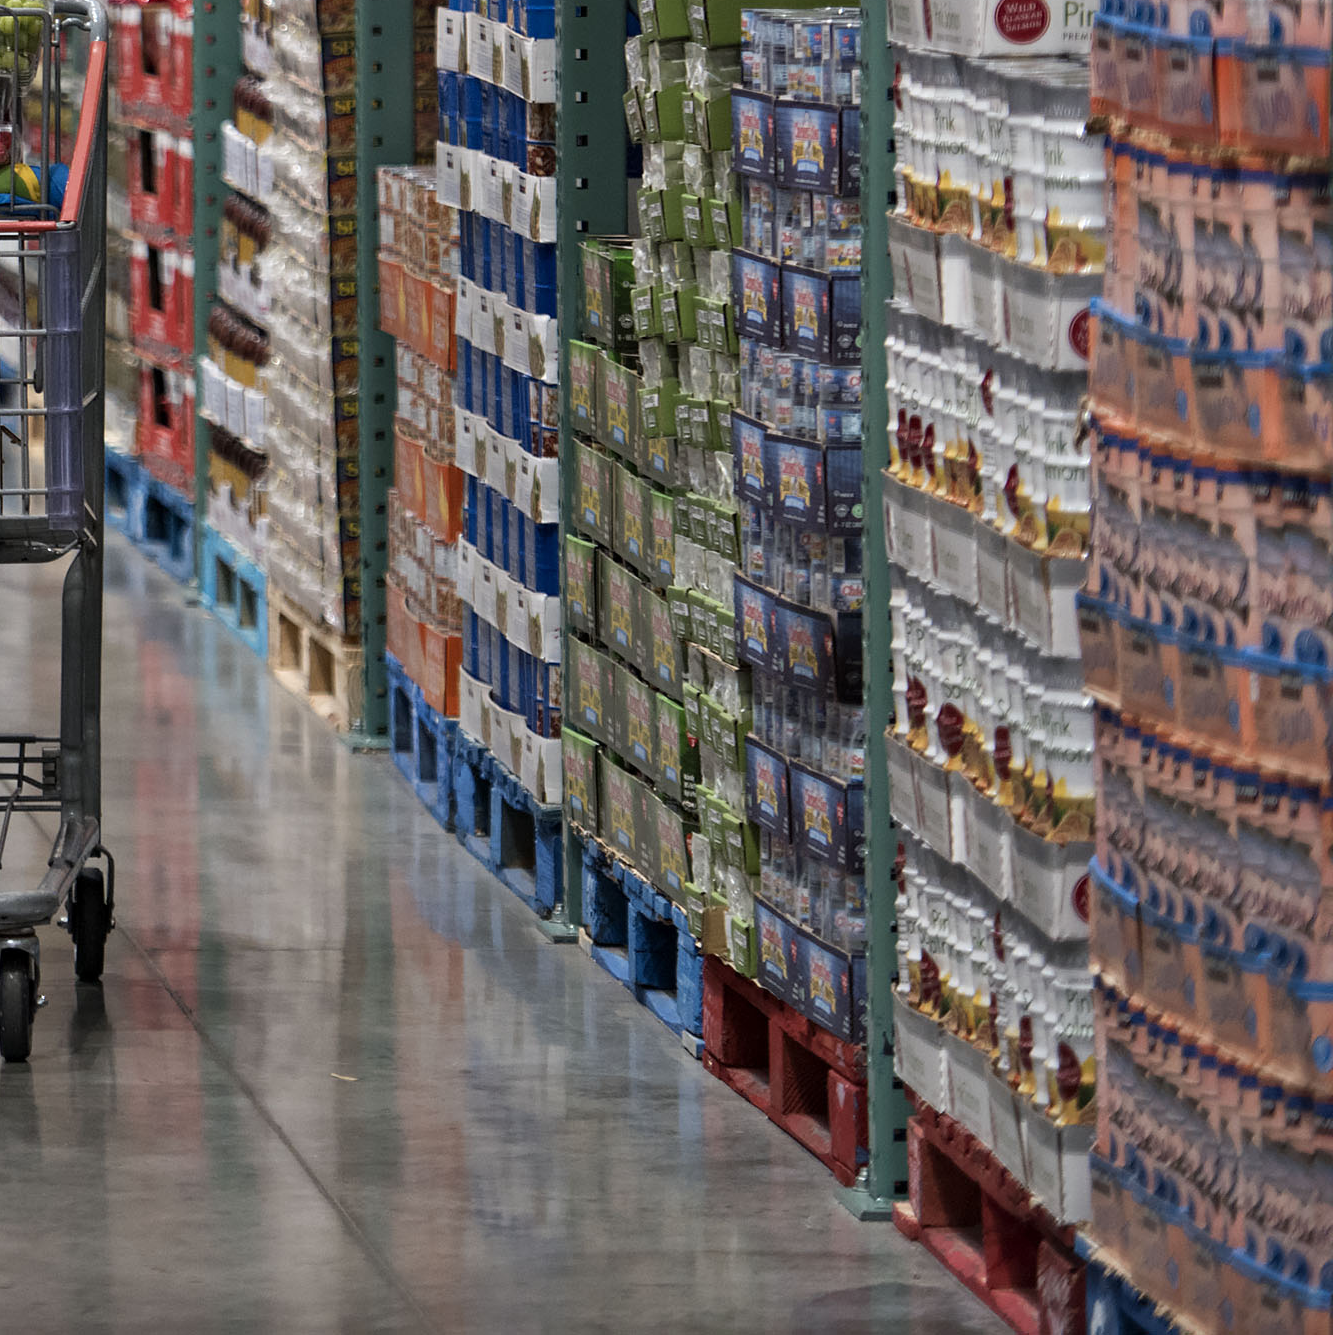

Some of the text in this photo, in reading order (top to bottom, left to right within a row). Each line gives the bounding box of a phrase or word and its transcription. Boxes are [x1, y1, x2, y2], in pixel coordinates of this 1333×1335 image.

[1005, 2, 1037, 14] WILD
[1002, 10, 1043, 24] ALASKAN
[1005, 20, 1042, 33] SALMON
